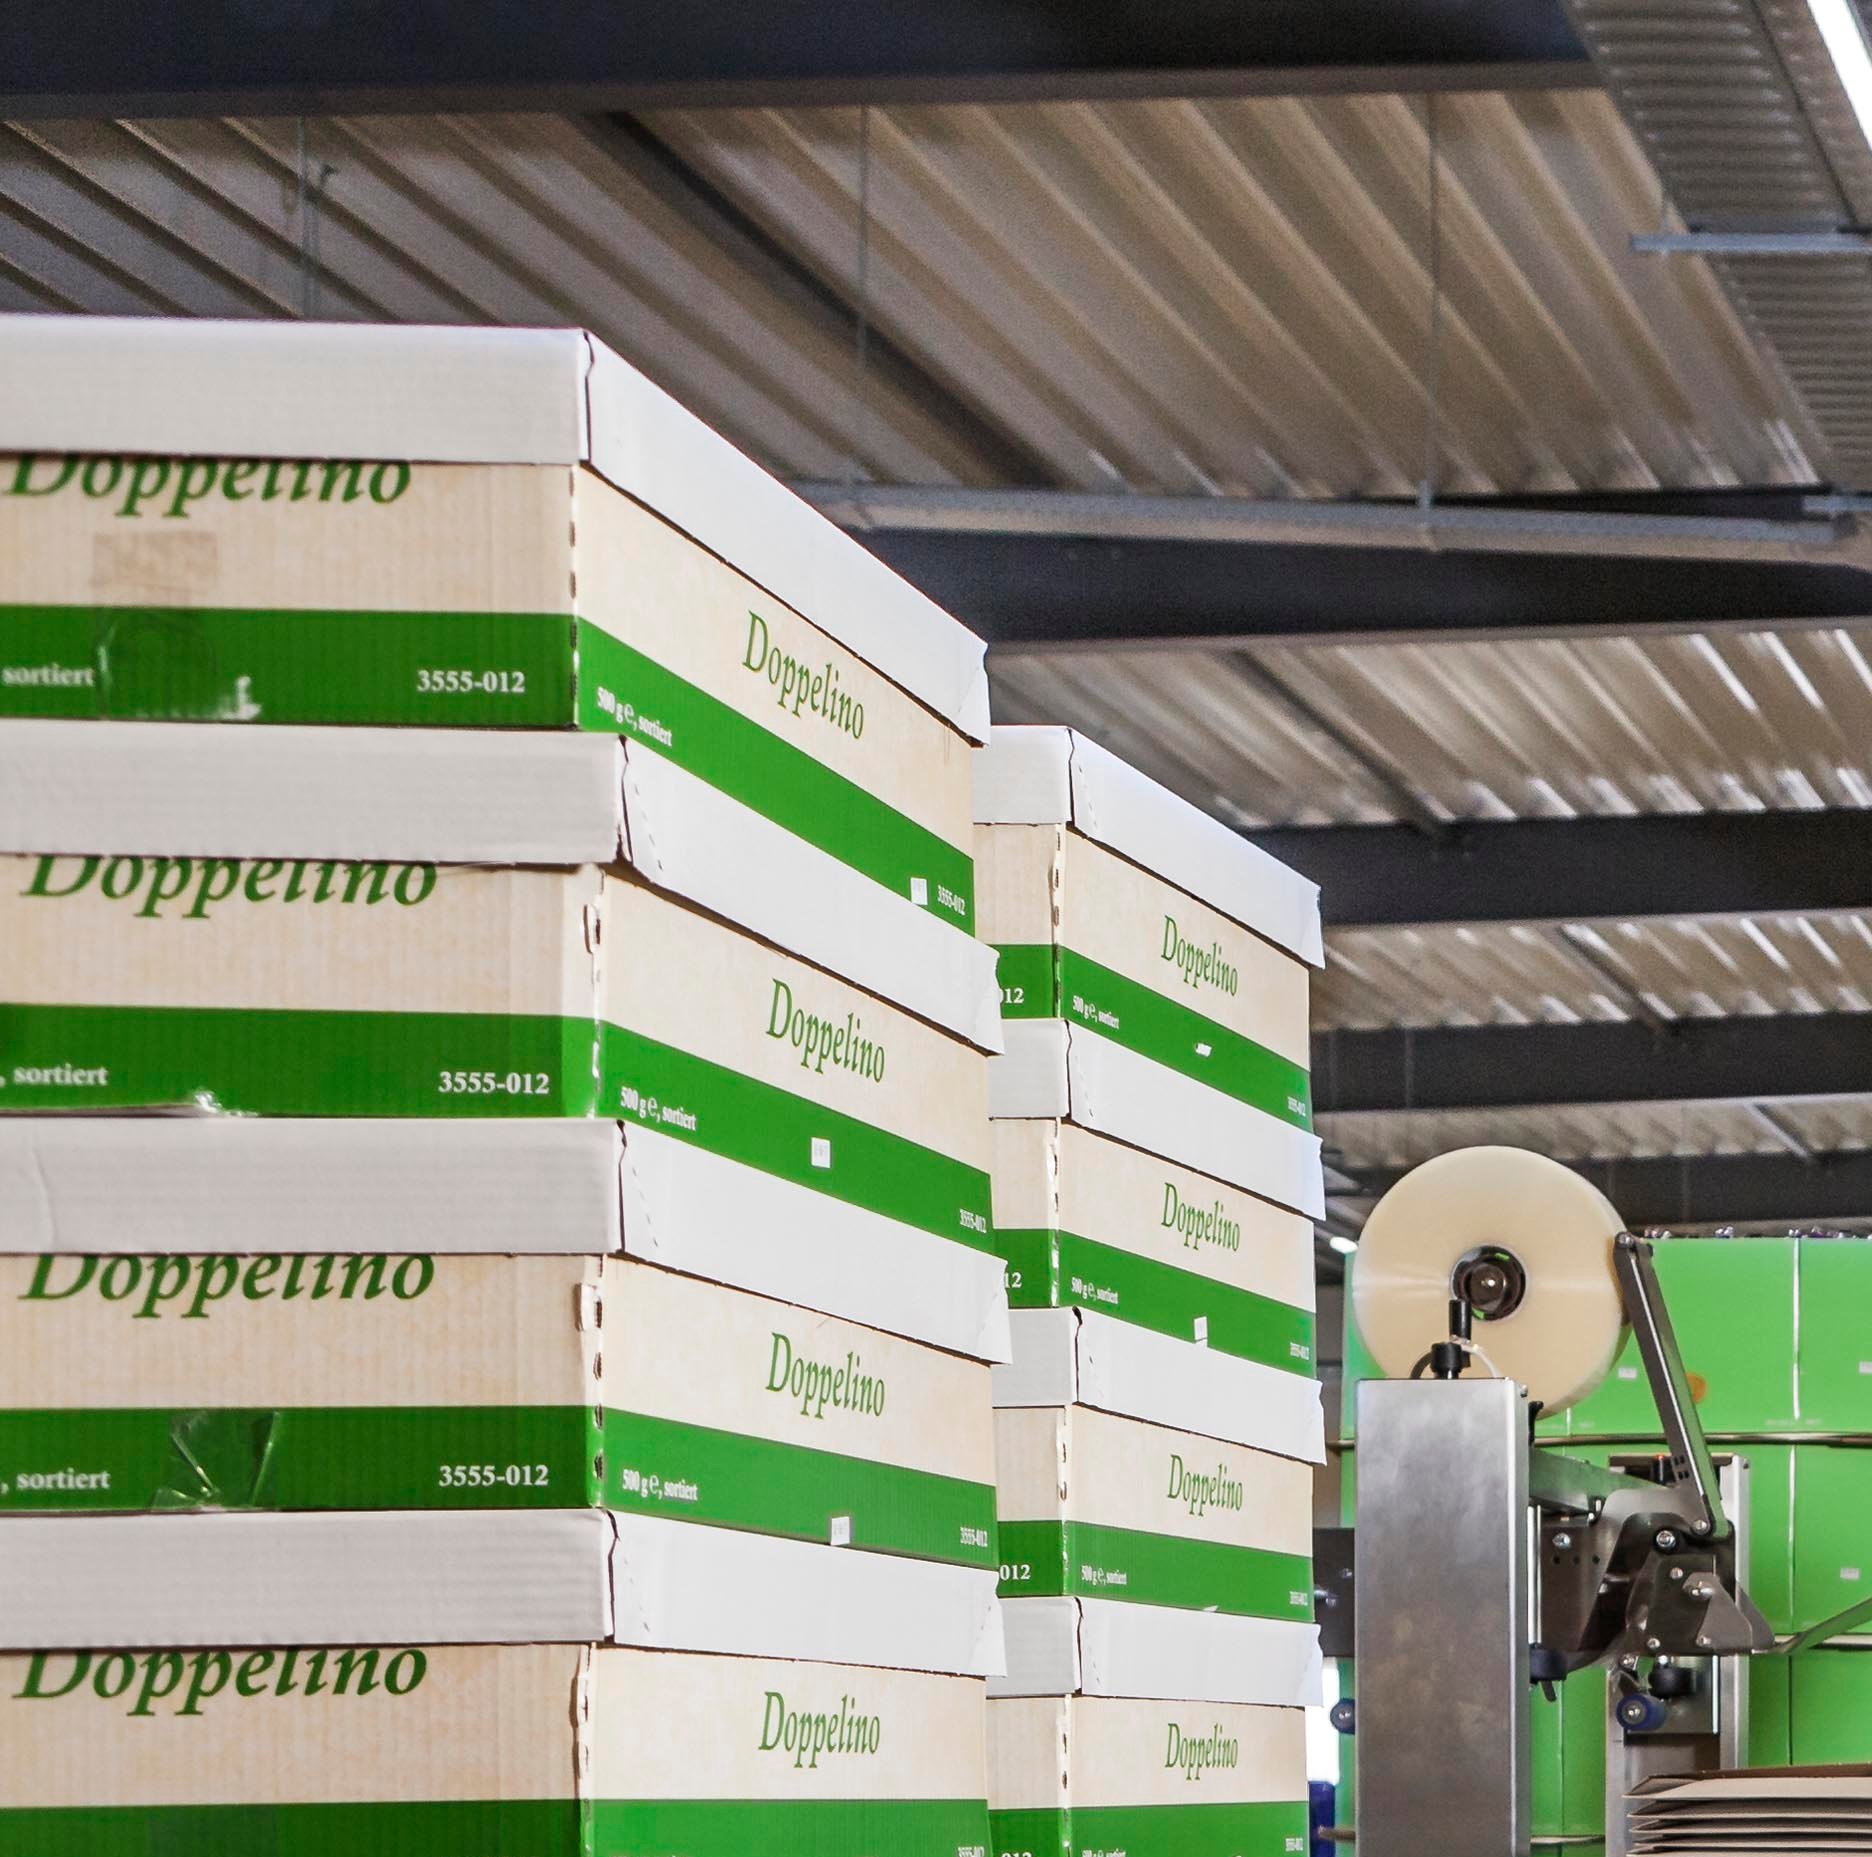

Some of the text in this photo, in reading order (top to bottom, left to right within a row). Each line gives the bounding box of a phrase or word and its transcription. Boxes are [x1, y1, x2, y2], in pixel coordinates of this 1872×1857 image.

[3, 455, 411, 518] Doppelino
[3, 664, 94, 687] sortiert
[416, 669, 525, 693] 3555-012
[743, 610, 864, 739] Doppelino
[20, 856, 437, 918] Doppelino
[937, 885, 966, 916] 3555-012
[1161, 914, 1239, 997] Doppelino
[765, 978, 885, 1083] Doppelino
[14, 1063, 108, 1086] sortiert
[438, 1072, 550, 1096] 3555-012
[620, 1086, 638, 1113] 500
[662, 1103, 696, 1131] sortiert
[1161, 1181, 1240, 1252] Doppelino
[18, 1254, 435, 1319] Doppelino
[765, 1332, 885, 1420] Doppelino
[16, 1467, 110, 1491] sortiert
[438, 1465, 550, 1488] 3555-012
[622, 1468, 640, 1494] 500
[663, 1479, 698, 1501] sortiert
[1167, 1454, 1243, 1517] Doppelino
[12, 1648, 428, 1716] Doppelino
[758, 1691, 880, 1768] Doppelino
[1165, 1723, 1239, 1780] Doppelino
